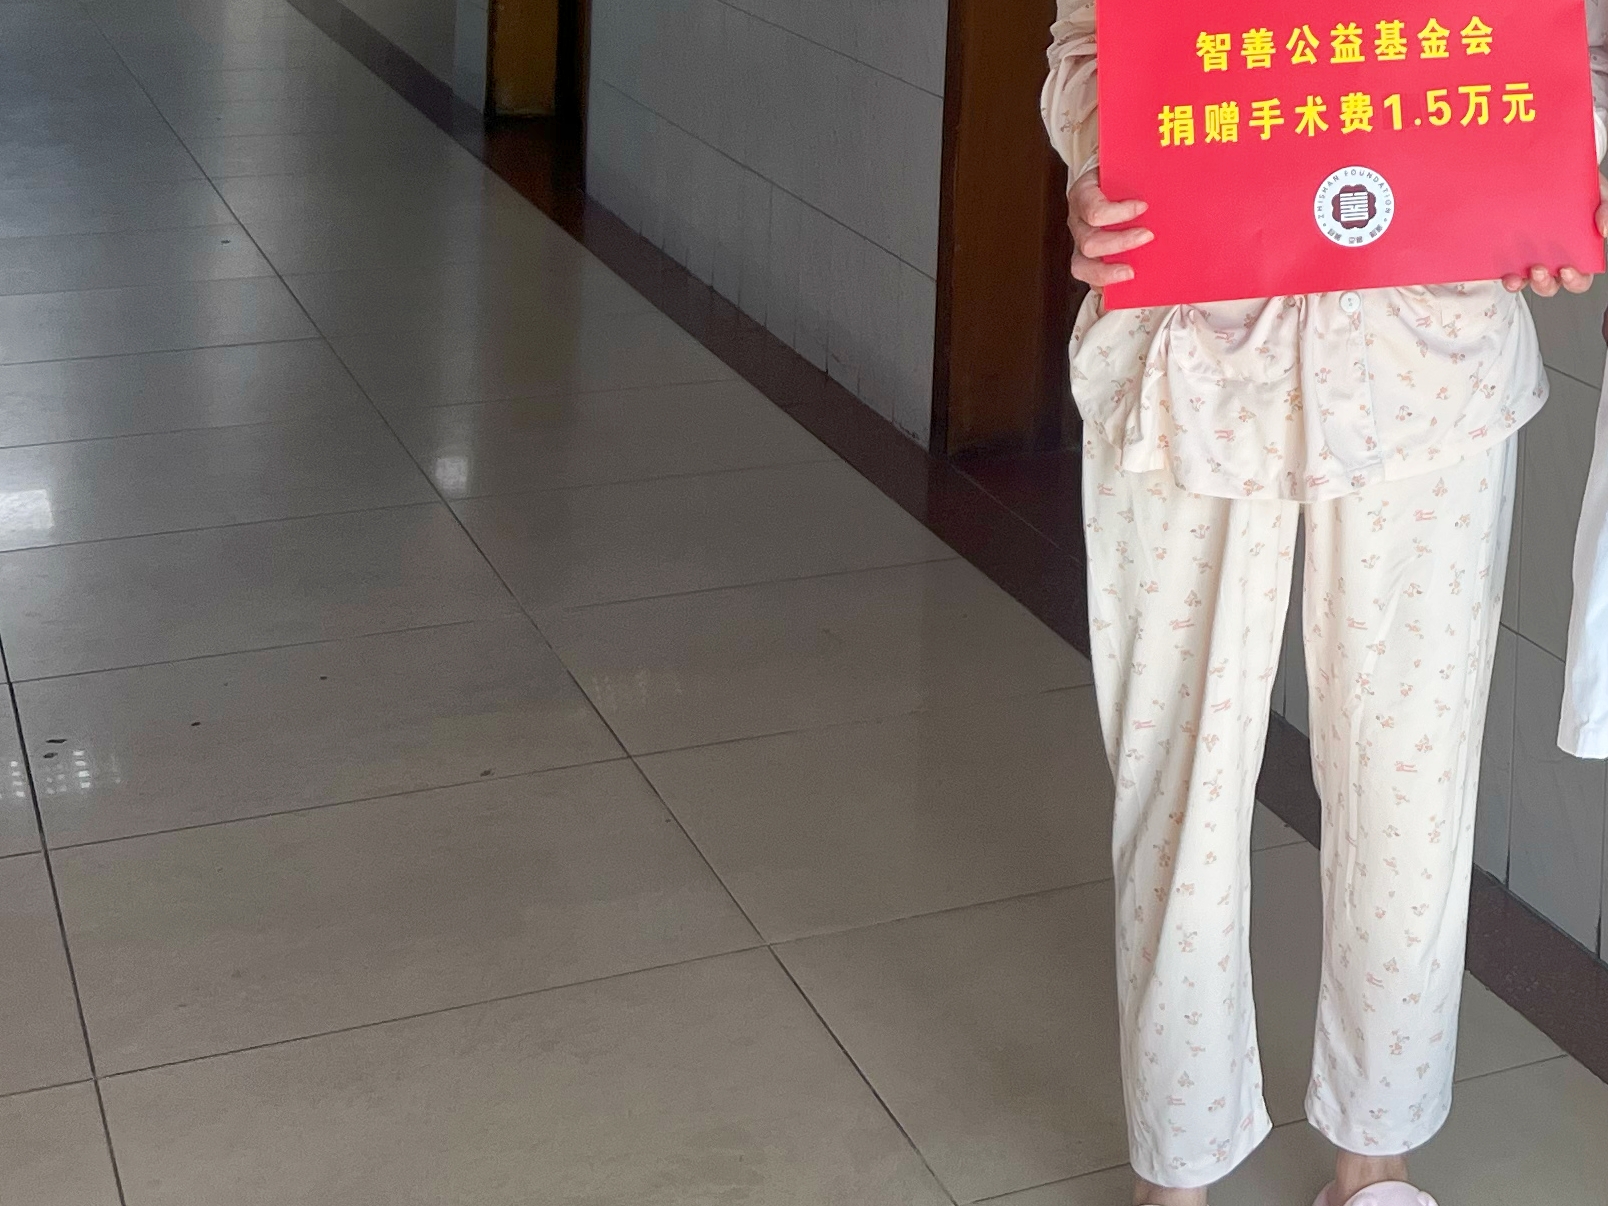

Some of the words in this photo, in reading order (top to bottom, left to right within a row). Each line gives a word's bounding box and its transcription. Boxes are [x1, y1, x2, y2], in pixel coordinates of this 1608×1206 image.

[1196, 15, 1494, 73] 智善公益基金会
[1158, 82, 1537, 147] 捐赠手术费1.5万元
[1344, 169, 1392, 214] FOUNDATION
